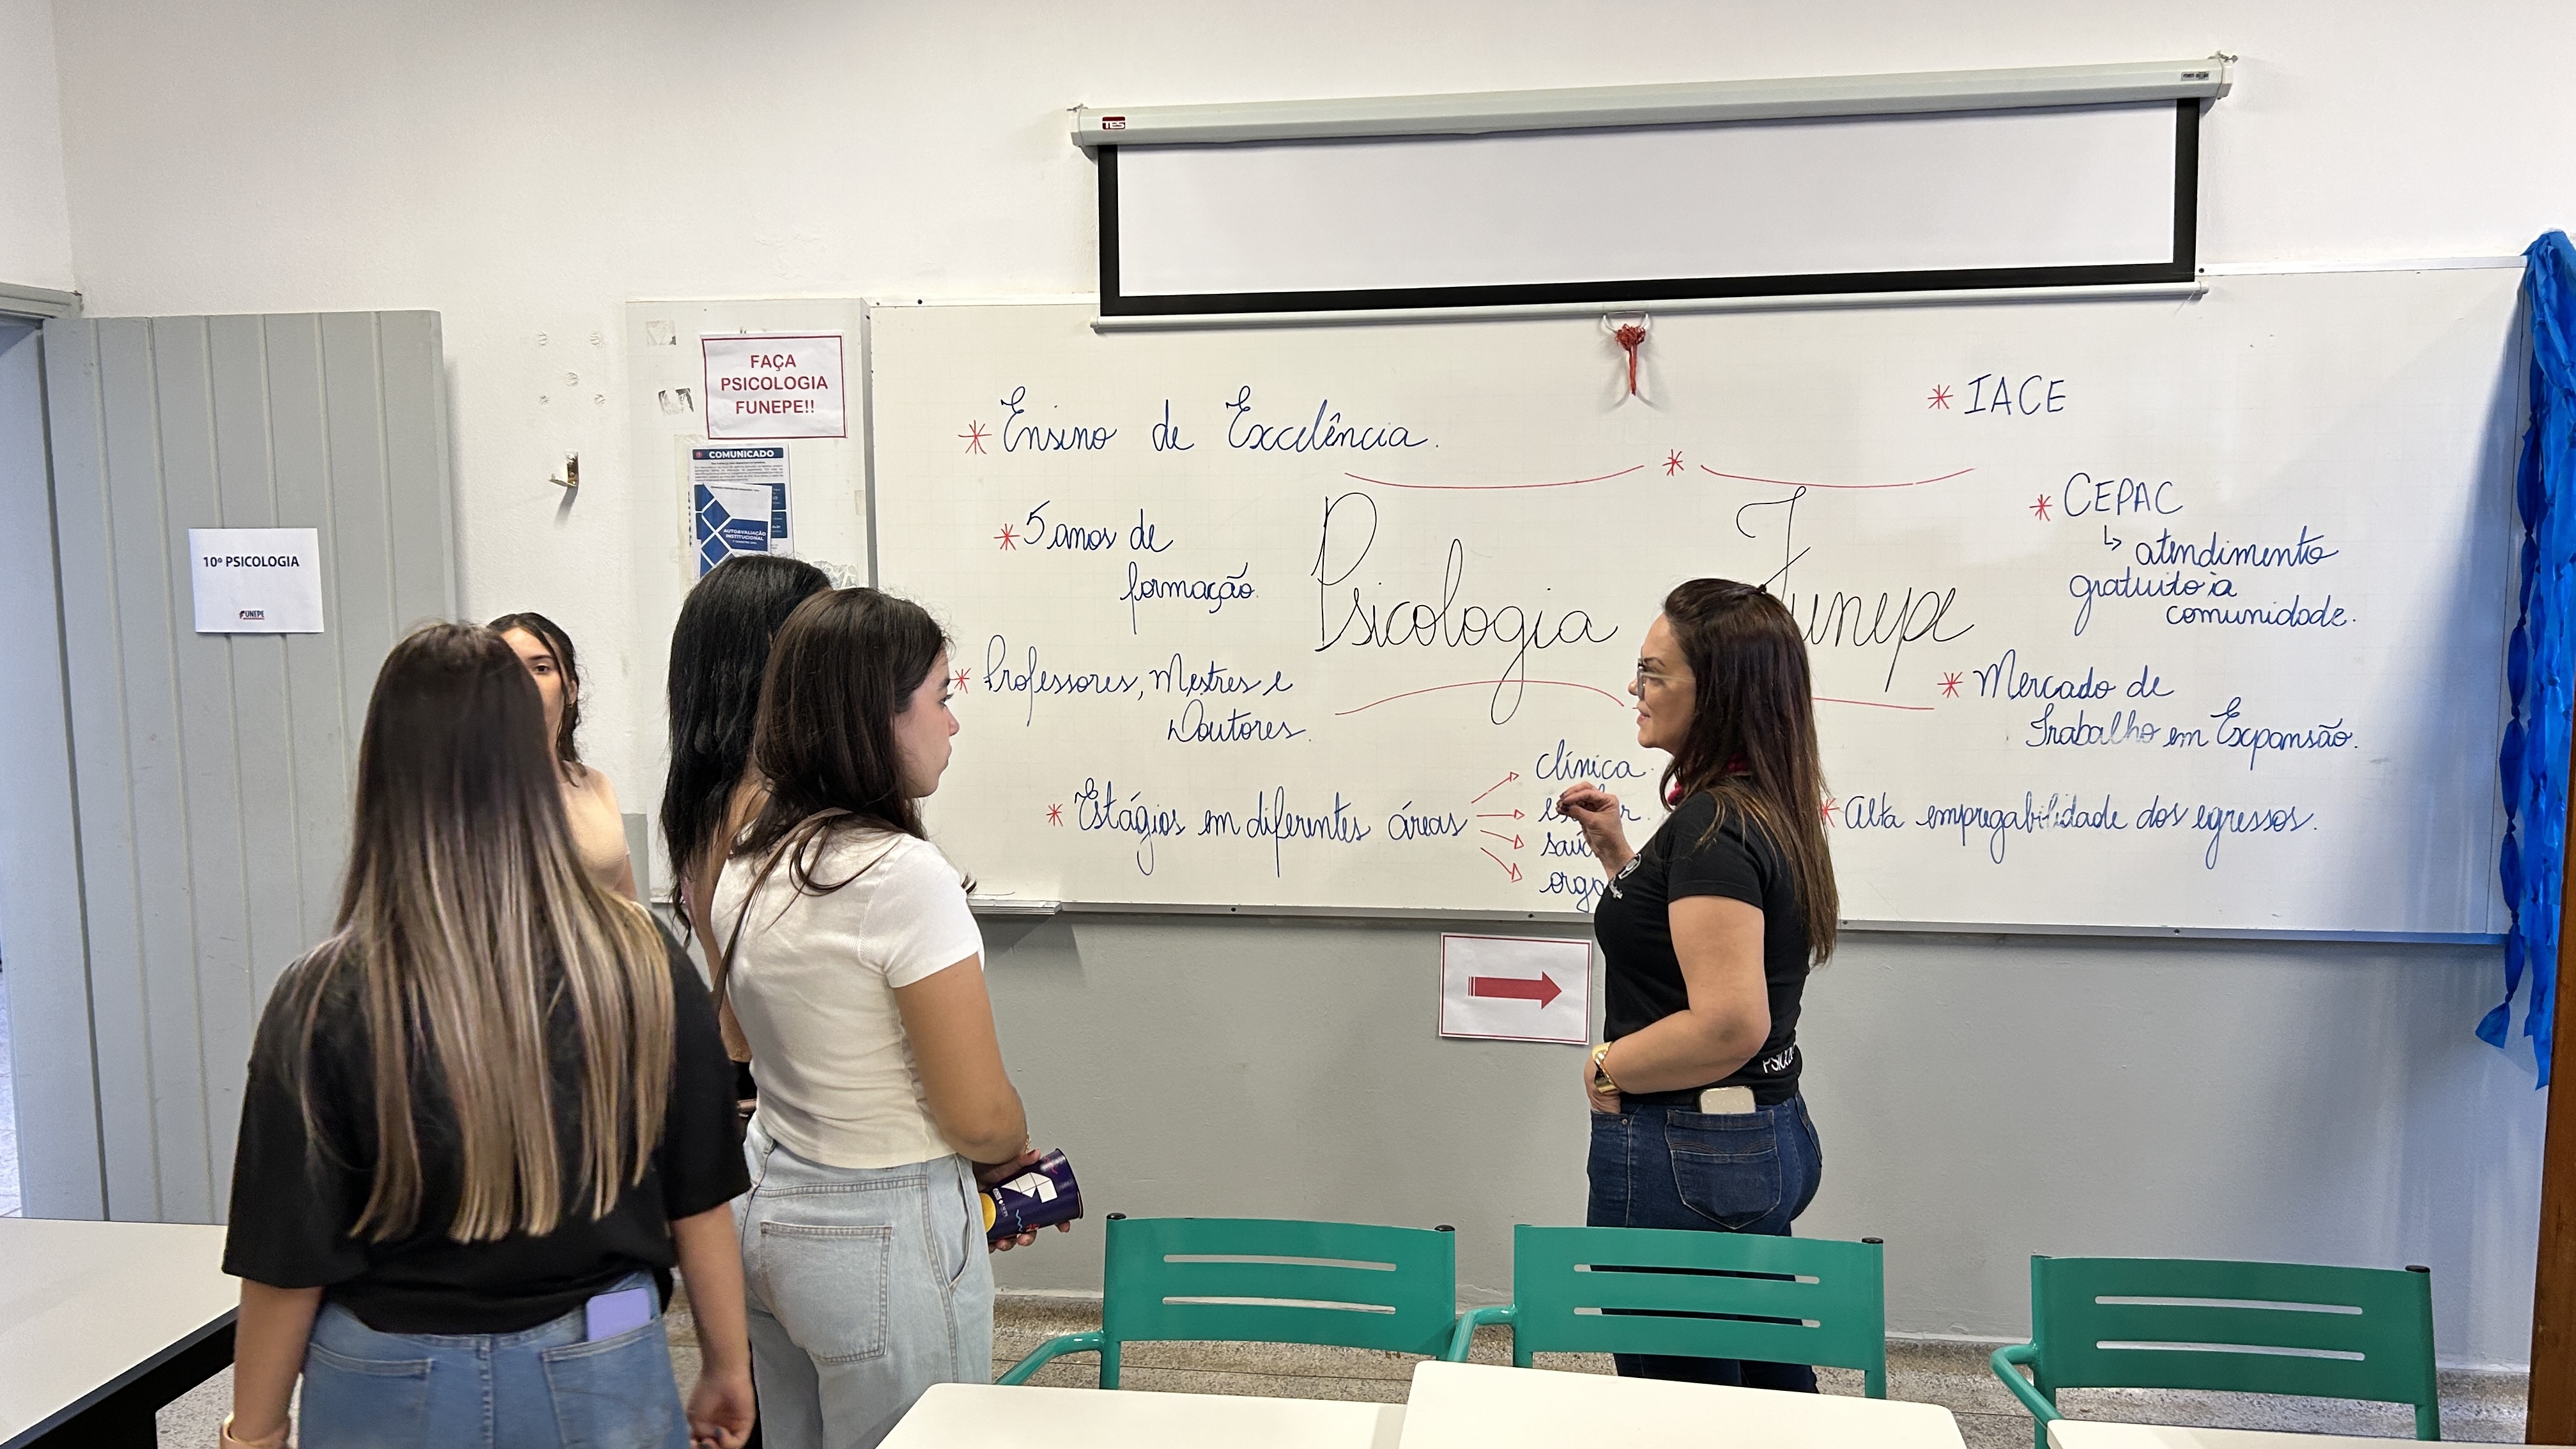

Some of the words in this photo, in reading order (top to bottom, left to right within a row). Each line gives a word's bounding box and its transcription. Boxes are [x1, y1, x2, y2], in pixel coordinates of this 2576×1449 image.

[721, 376, 829, 392] PSICOLOGIA
[750, 354, 797, 371] FAÇA
[735, 400, 815, 415] FUNEPE!!
[1964, 374, 2066, 415] IACE
[1000, 386, 1117, 452] Ensino
[1153, 399, 1195, 451] de
[709, 450, 774, 459] COMUNICADO
[2064, 473, 2183, 517] CEPAC
[1023, 500, 1050, 544] 5
[1046, 528, 1117, 551] anos
[1130, 509, 1174, 553] de
[2136, 525, 2339, 567] atendimento
[226, 556, 300, 567] PSICOLOGIA
[239, 610, 264, 620] FUNEPE
[1311, 493, 1619, 724] Psicologia
[2069, 567, 2206, 636] gratuito
[1149, 653, 1261, 697] Mestres
[1262, 671, 1293, 696] e
[1973, 649, 2116, 700] Mercado
[2126, 665, 2174, 698] de
[2025, 704, 2163, 747] Trabalho
[2163, 727, 2209, 748] em
[1075, 778, 1186, 875] Estágios
[1198, 813, 1241, 836] em
[1246, 786, 1370, 878] diferentes
[1388, 801, 1468, 840] áreas
[1845, 794, 1905, 829] Alta
[1915, 791, 2128, 864] empregabilidade
[2136, 795, 2189, 829] dos
